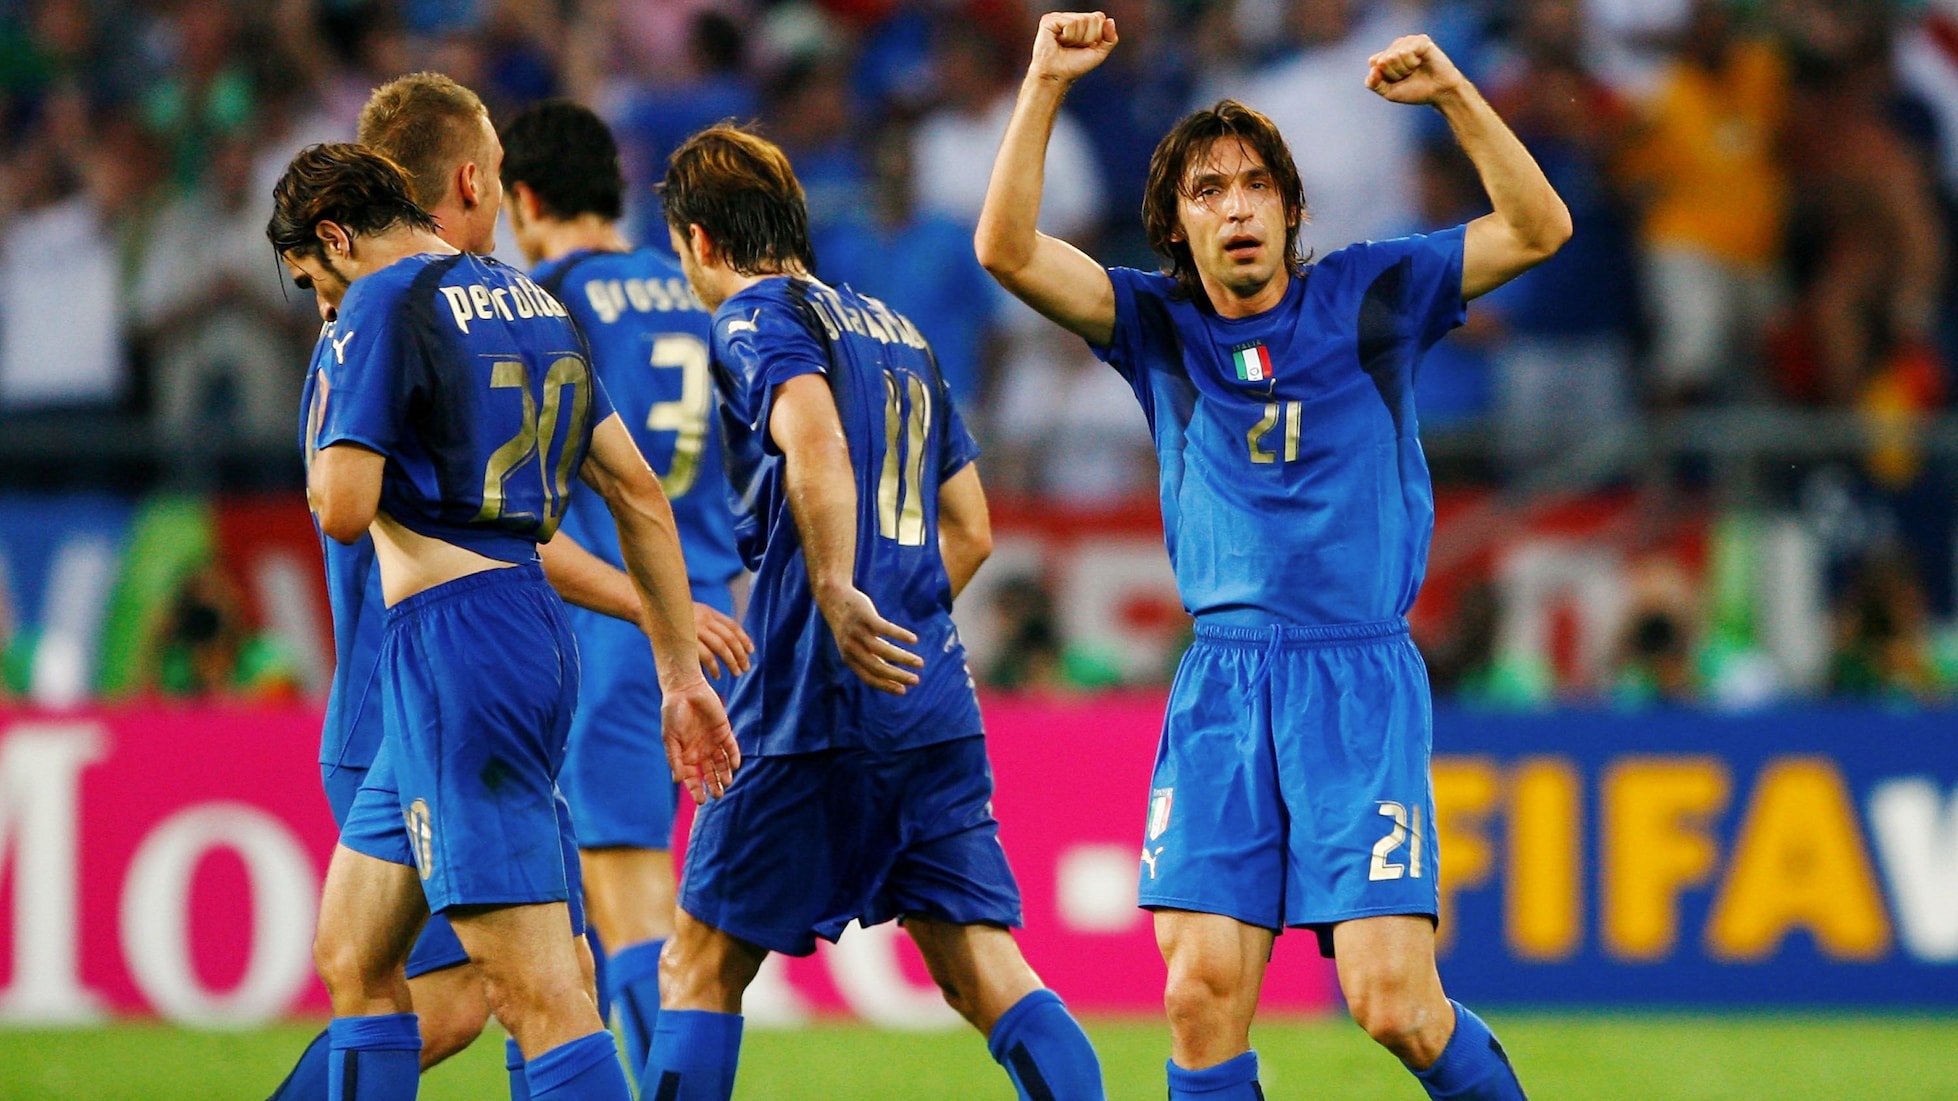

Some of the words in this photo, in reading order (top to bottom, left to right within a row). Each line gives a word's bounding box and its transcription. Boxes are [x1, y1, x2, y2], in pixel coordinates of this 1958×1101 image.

[1231, 339, 1262, 352] ITALIA
[470, 352, 591, 544] 20
[647, 335, 712, 498] 3
[877, 367, 932, 546] 11
[1246, 400, 1303, 464] 21
[403, 798, 432, 880] 0
[1368, 801, 1422, 881] 21
[1428, 755, 1895, 963] FIFA
